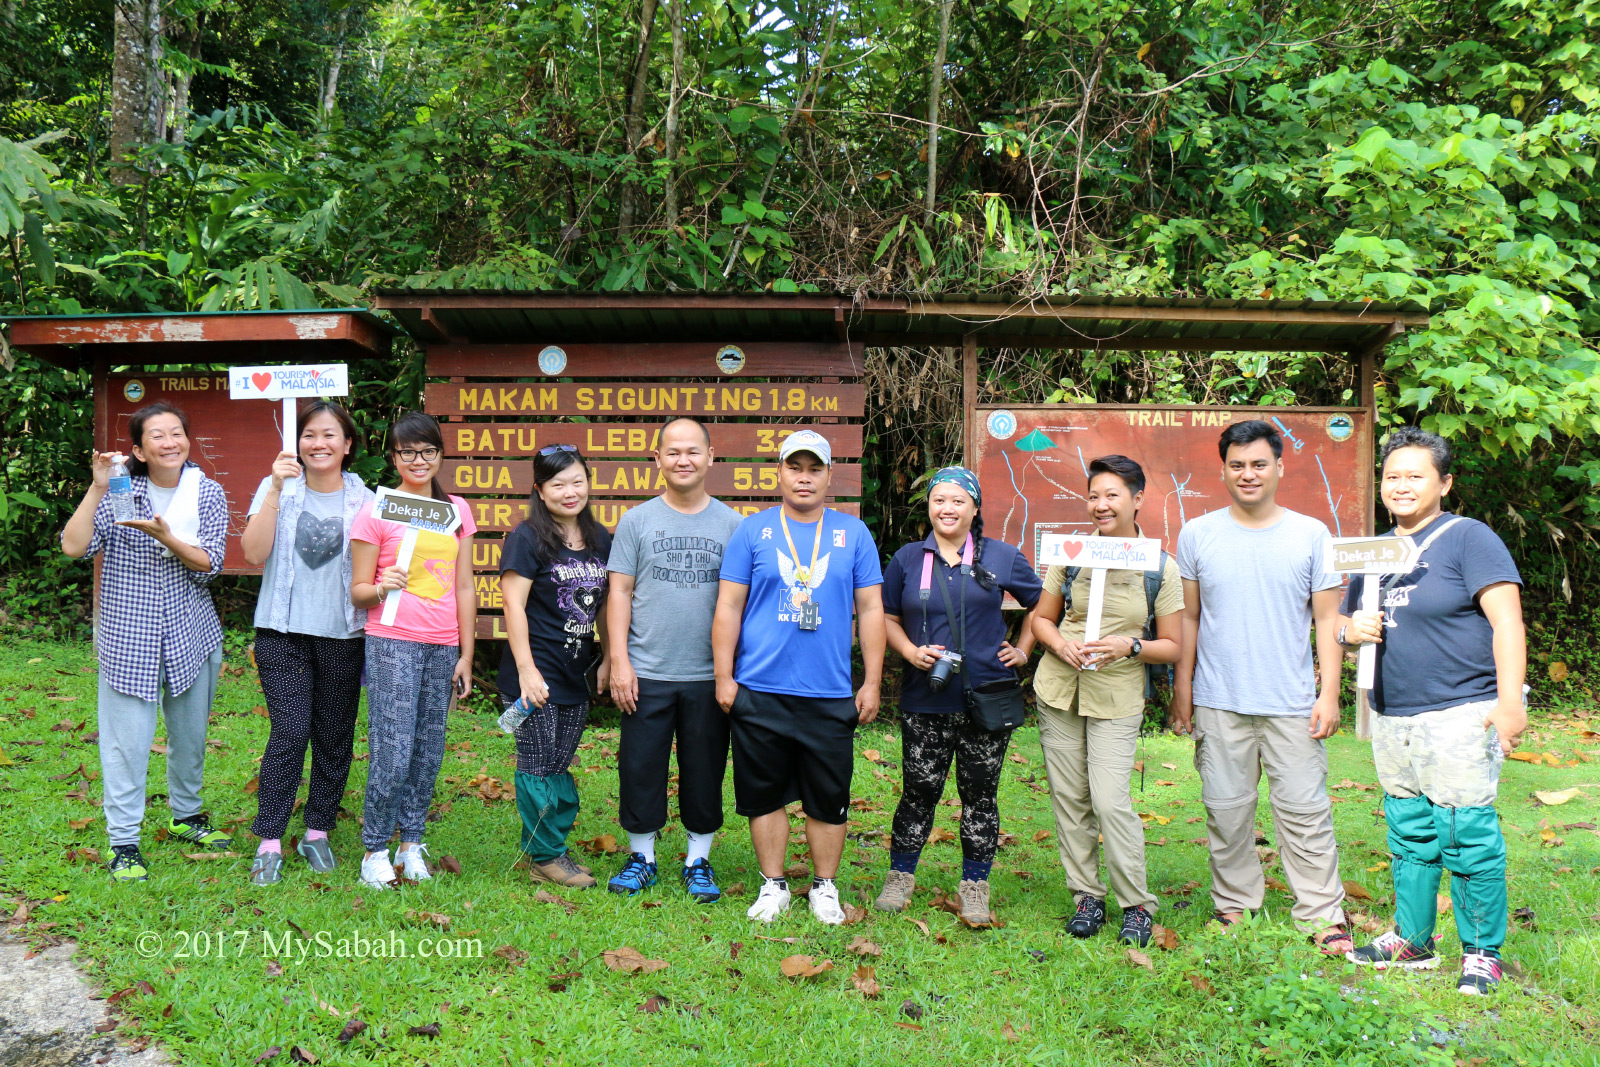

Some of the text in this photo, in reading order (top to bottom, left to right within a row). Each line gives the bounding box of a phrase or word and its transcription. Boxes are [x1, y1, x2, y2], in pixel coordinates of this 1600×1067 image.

[273, 370, 311, 380] TOURISM
[159, 377, 210, 391] TRAILS
[281, 378, 336, 394] MALAYSIA
[459, 387, 838, 412] MAKAM SIGUNTING 1.8 KM
[1125, 410, 1232, 427] TRAIL MAP
[457, 428, 536, 451] BATU
[455, 466, 513, 488] GUA
[733, 467, 778, 491] 5.5
[426, 508, 440, 520] Je
[410, 517, 447, 533] SABAH
[655, 530, 665, 538] THE
[1085, 540, 1124, 551] TOURISM
[1378, 546, 1395, 560] Je
[666, 552, 711, 564] SHO CHU
[1091, 550, 1147, 568] MALAYSIA
[652, 565, 696, 584] TOKYO
[778, 613, 790, 622] KK
